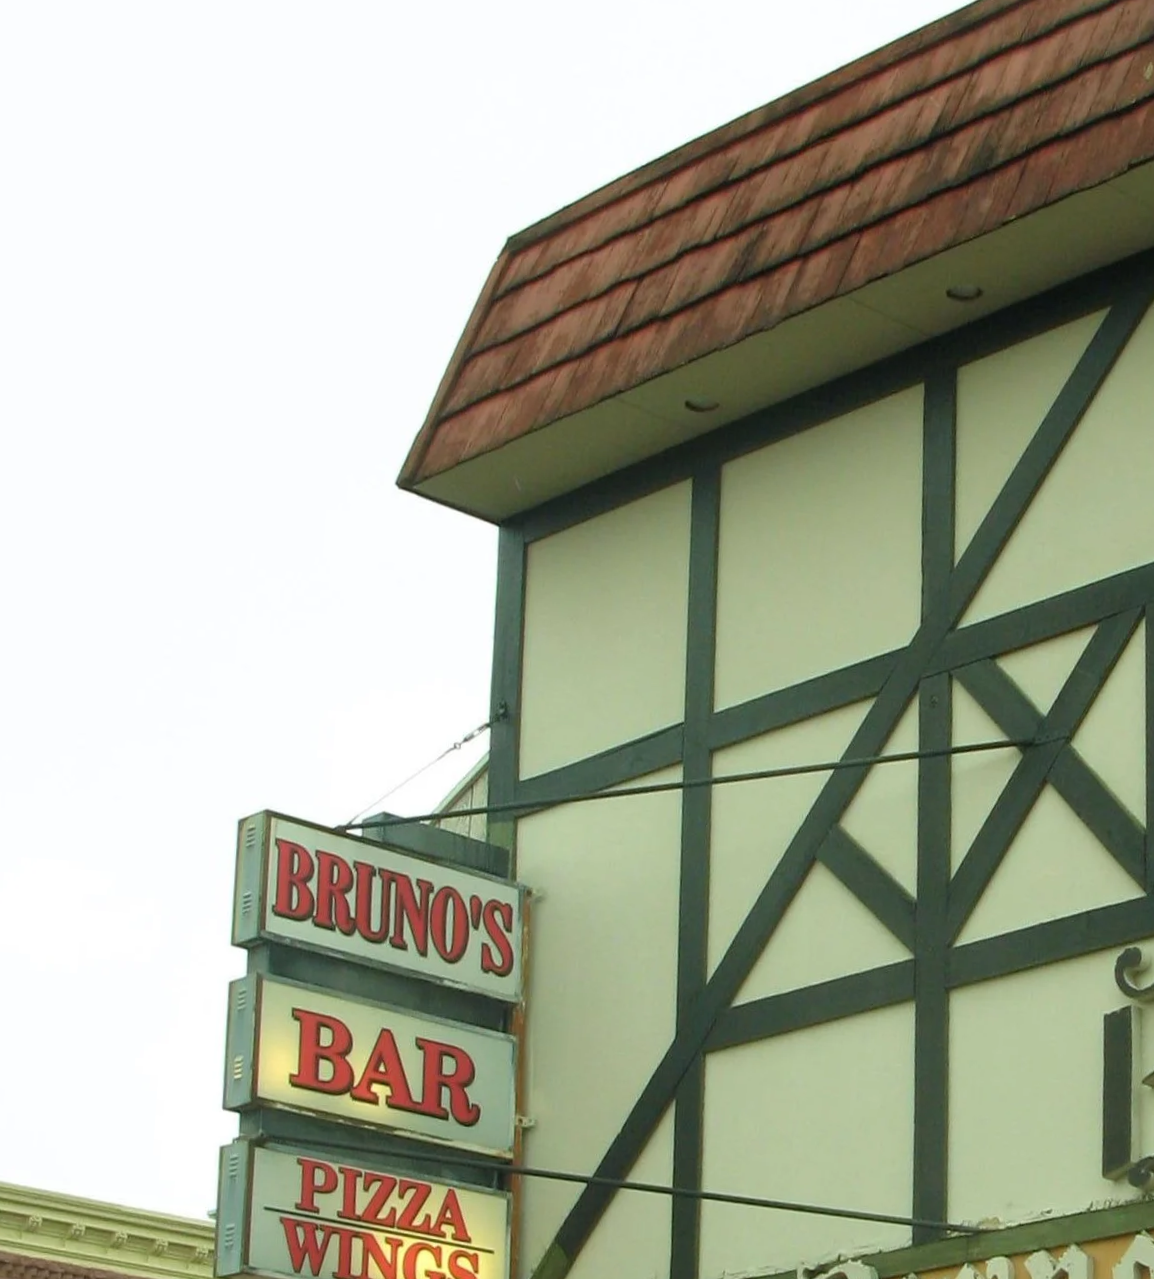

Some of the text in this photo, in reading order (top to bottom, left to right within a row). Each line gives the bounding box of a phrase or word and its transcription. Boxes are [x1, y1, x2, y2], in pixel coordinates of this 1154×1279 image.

[273, 838, 514, 976] BRUNO'S
[289, 1007, 481, 1127] BAR
[296, 1156, 472, 1243] PIZZA
